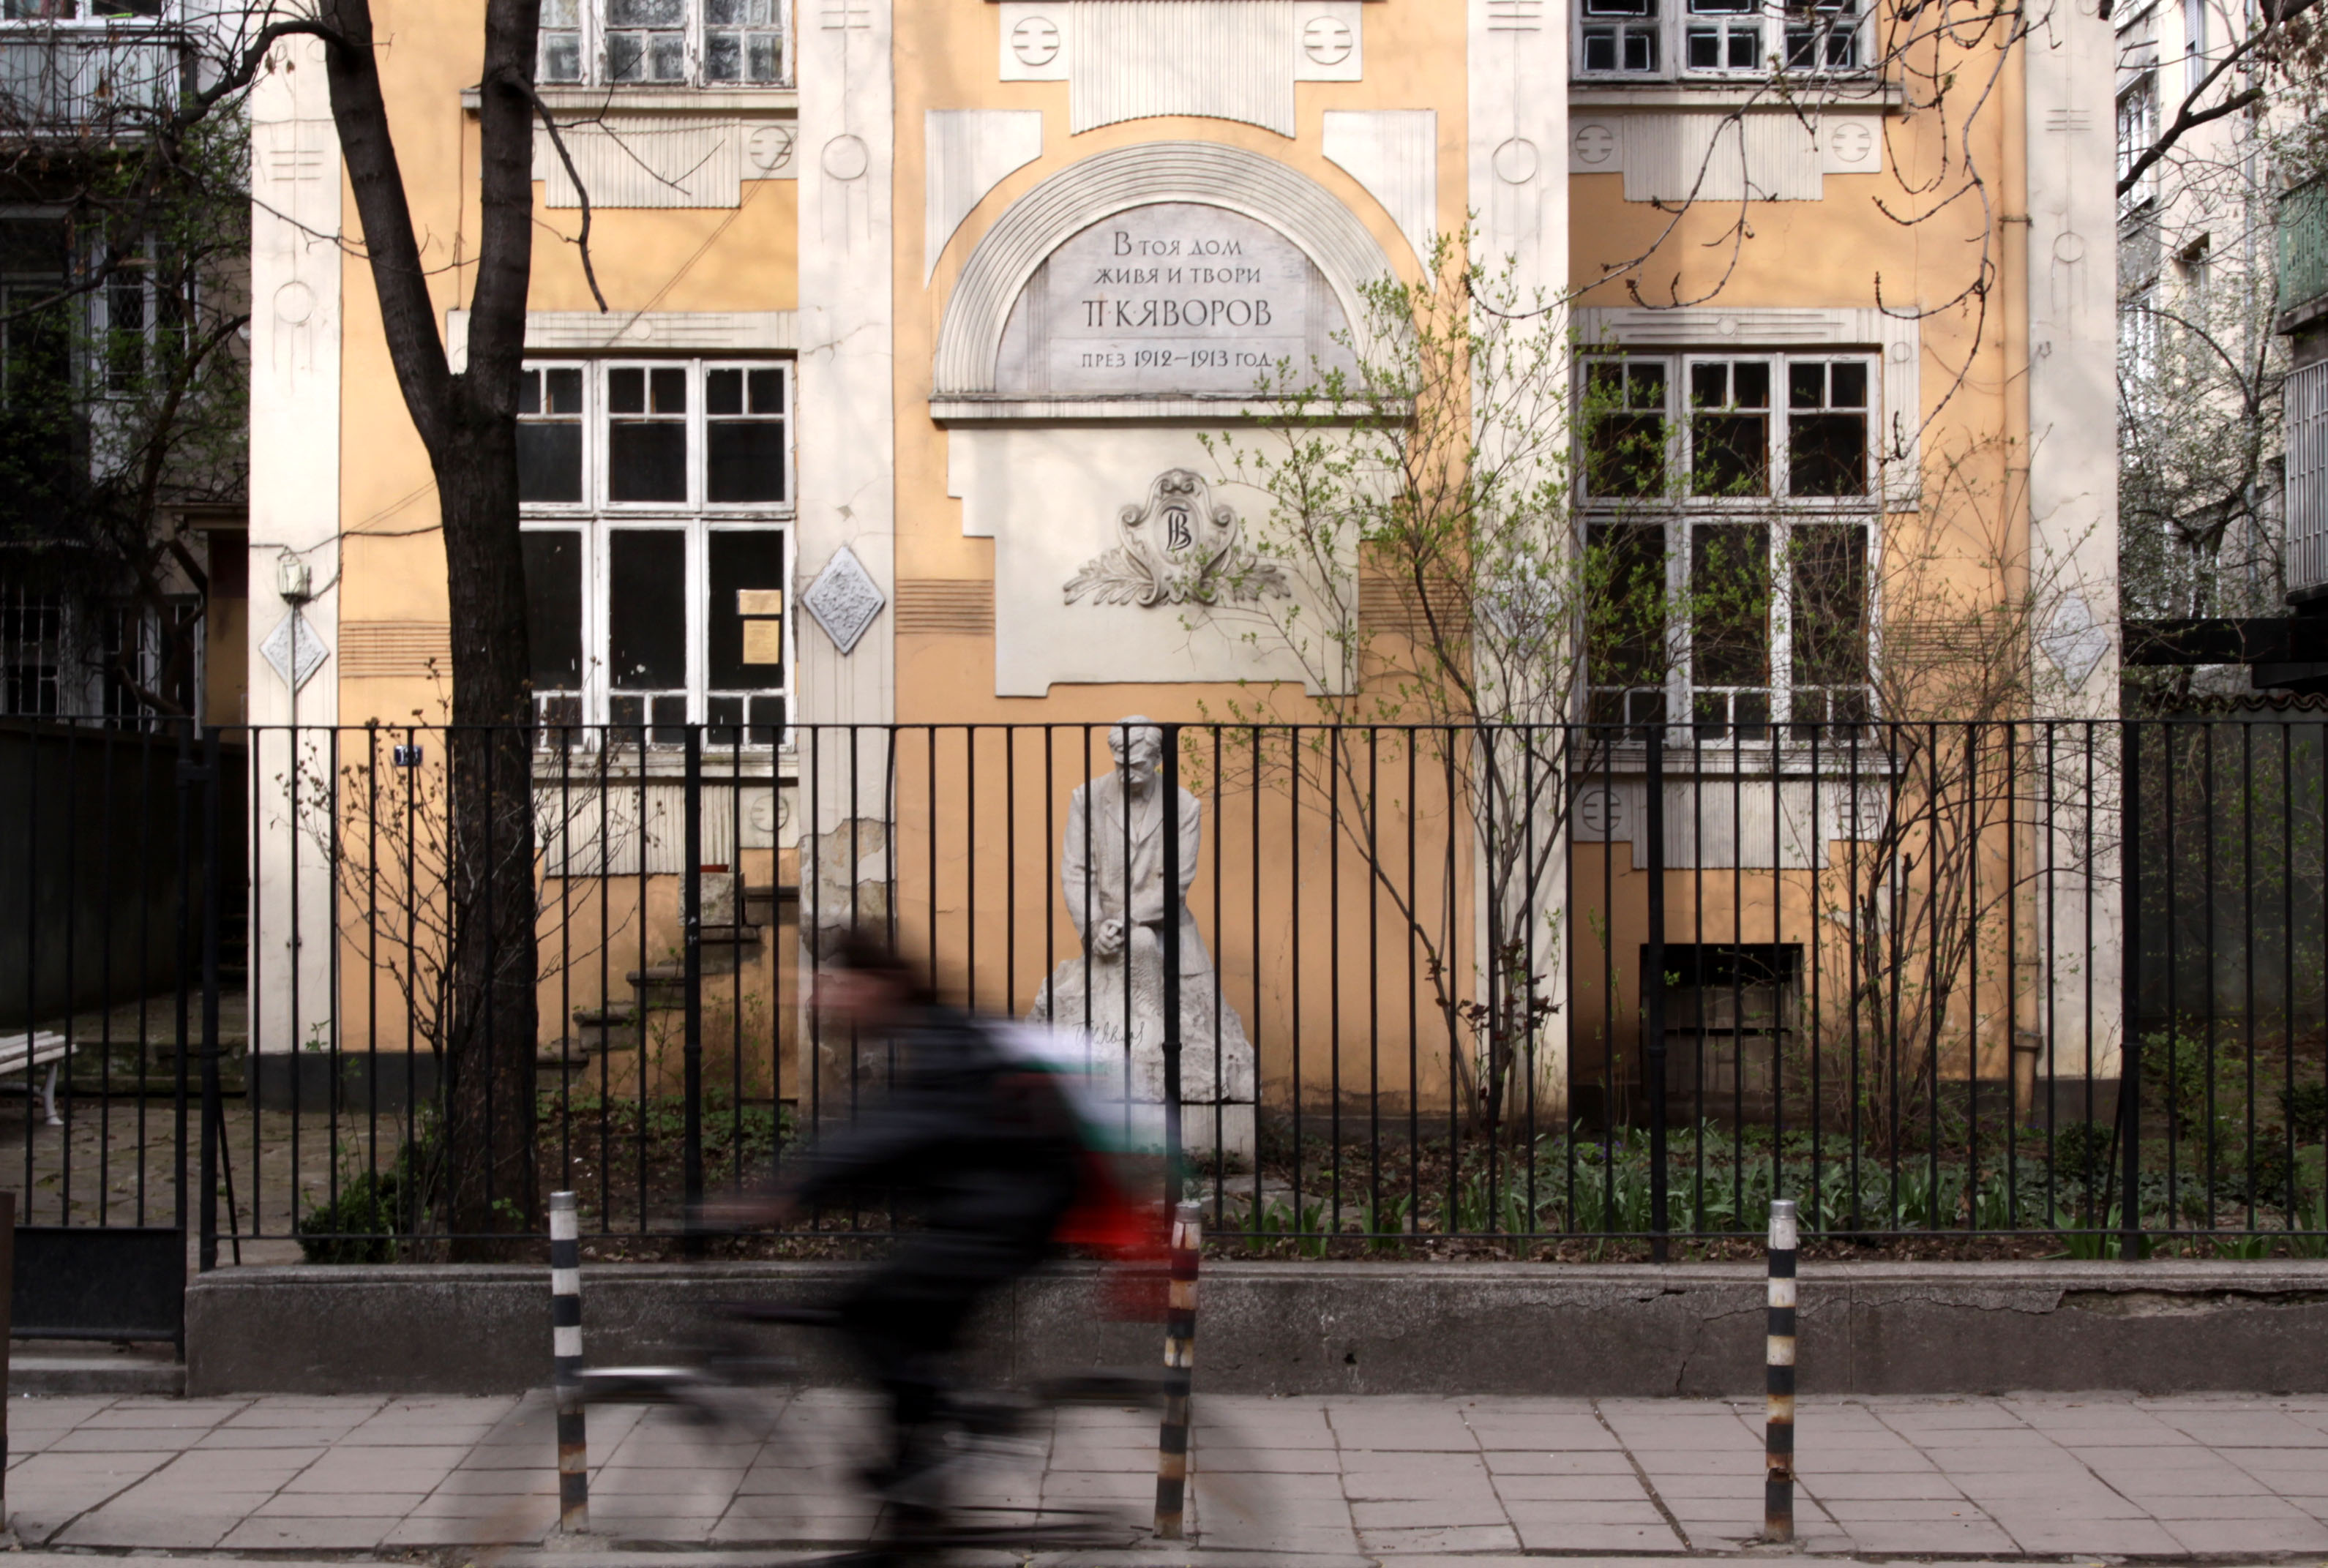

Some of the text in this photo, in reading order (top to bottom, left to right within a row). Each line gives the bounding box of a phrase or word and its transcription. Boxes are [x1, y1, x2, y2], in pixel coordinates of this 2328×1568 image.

[1114, 230, 1132, 256] В
[1093, 266, 1260, 285] ЖИВЯ И ТВОРИ
[1082, 353, 1126, 367] ПРЕЗ
